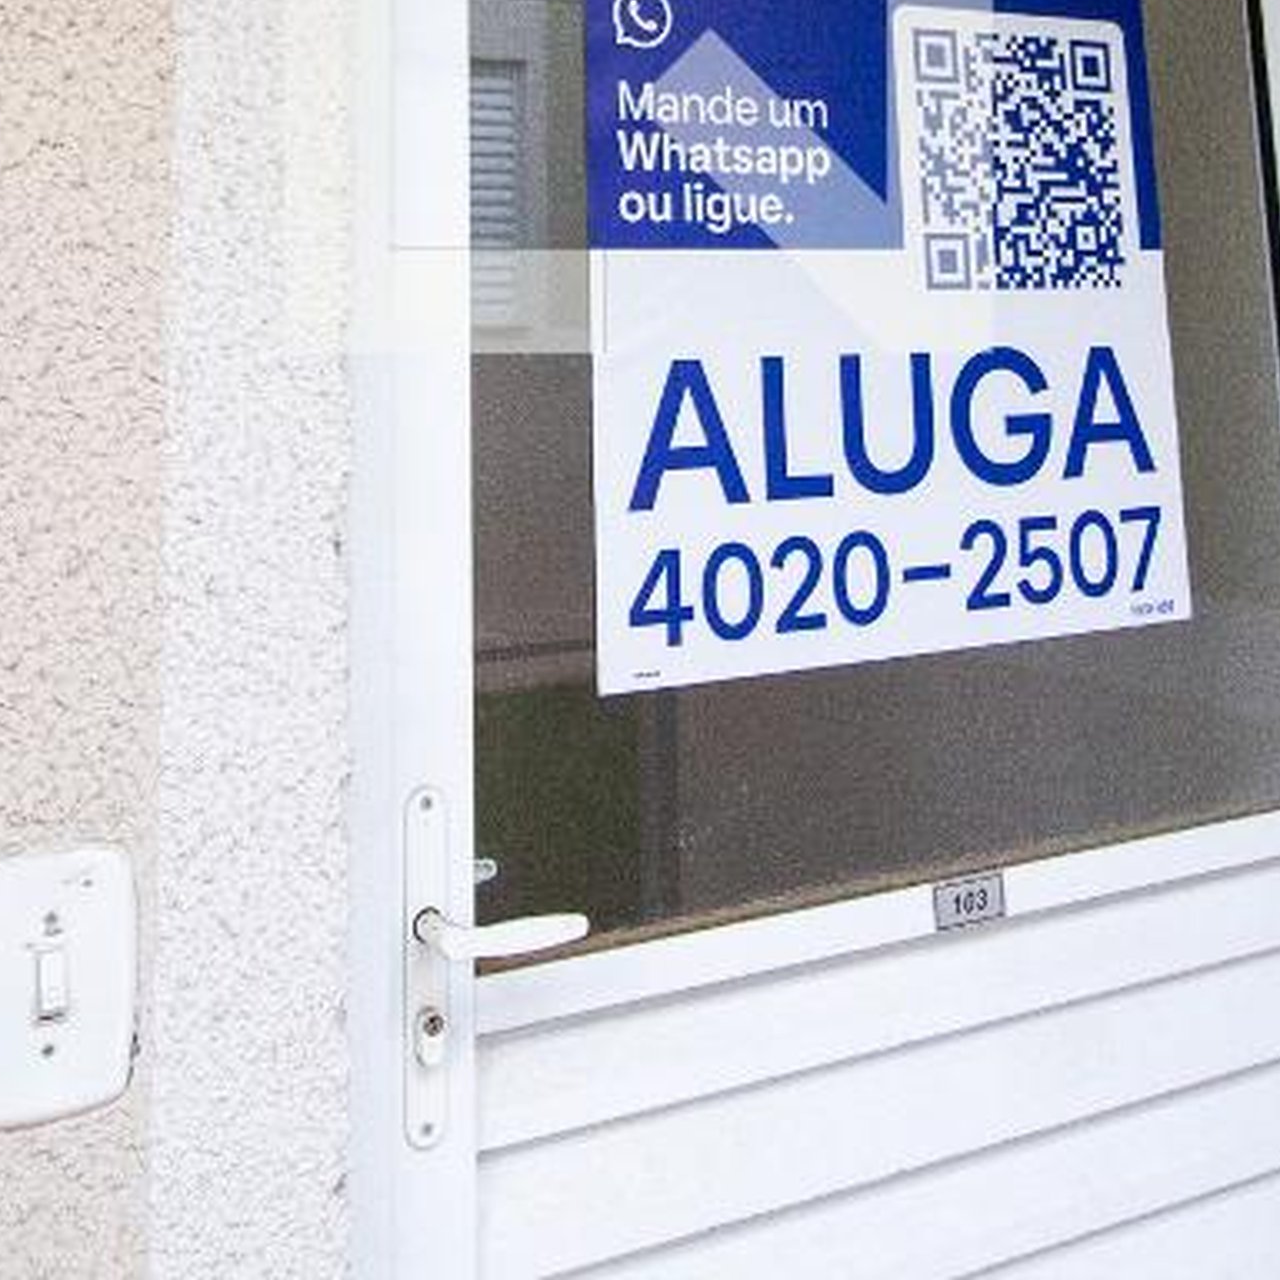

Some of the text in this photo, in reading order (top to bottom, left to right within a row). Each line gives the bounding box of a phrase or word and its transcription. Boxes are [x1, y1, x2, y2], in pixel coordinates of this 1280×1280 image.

[617, 81, 829, 129] Mande um
[617, 131, 831, 183] Whatsapp
[619, 183, 796, 234] ou ligue.
[627, 345, 1157, 511] ALUGA
[628, 506, 1162, 647] 4020-2507
